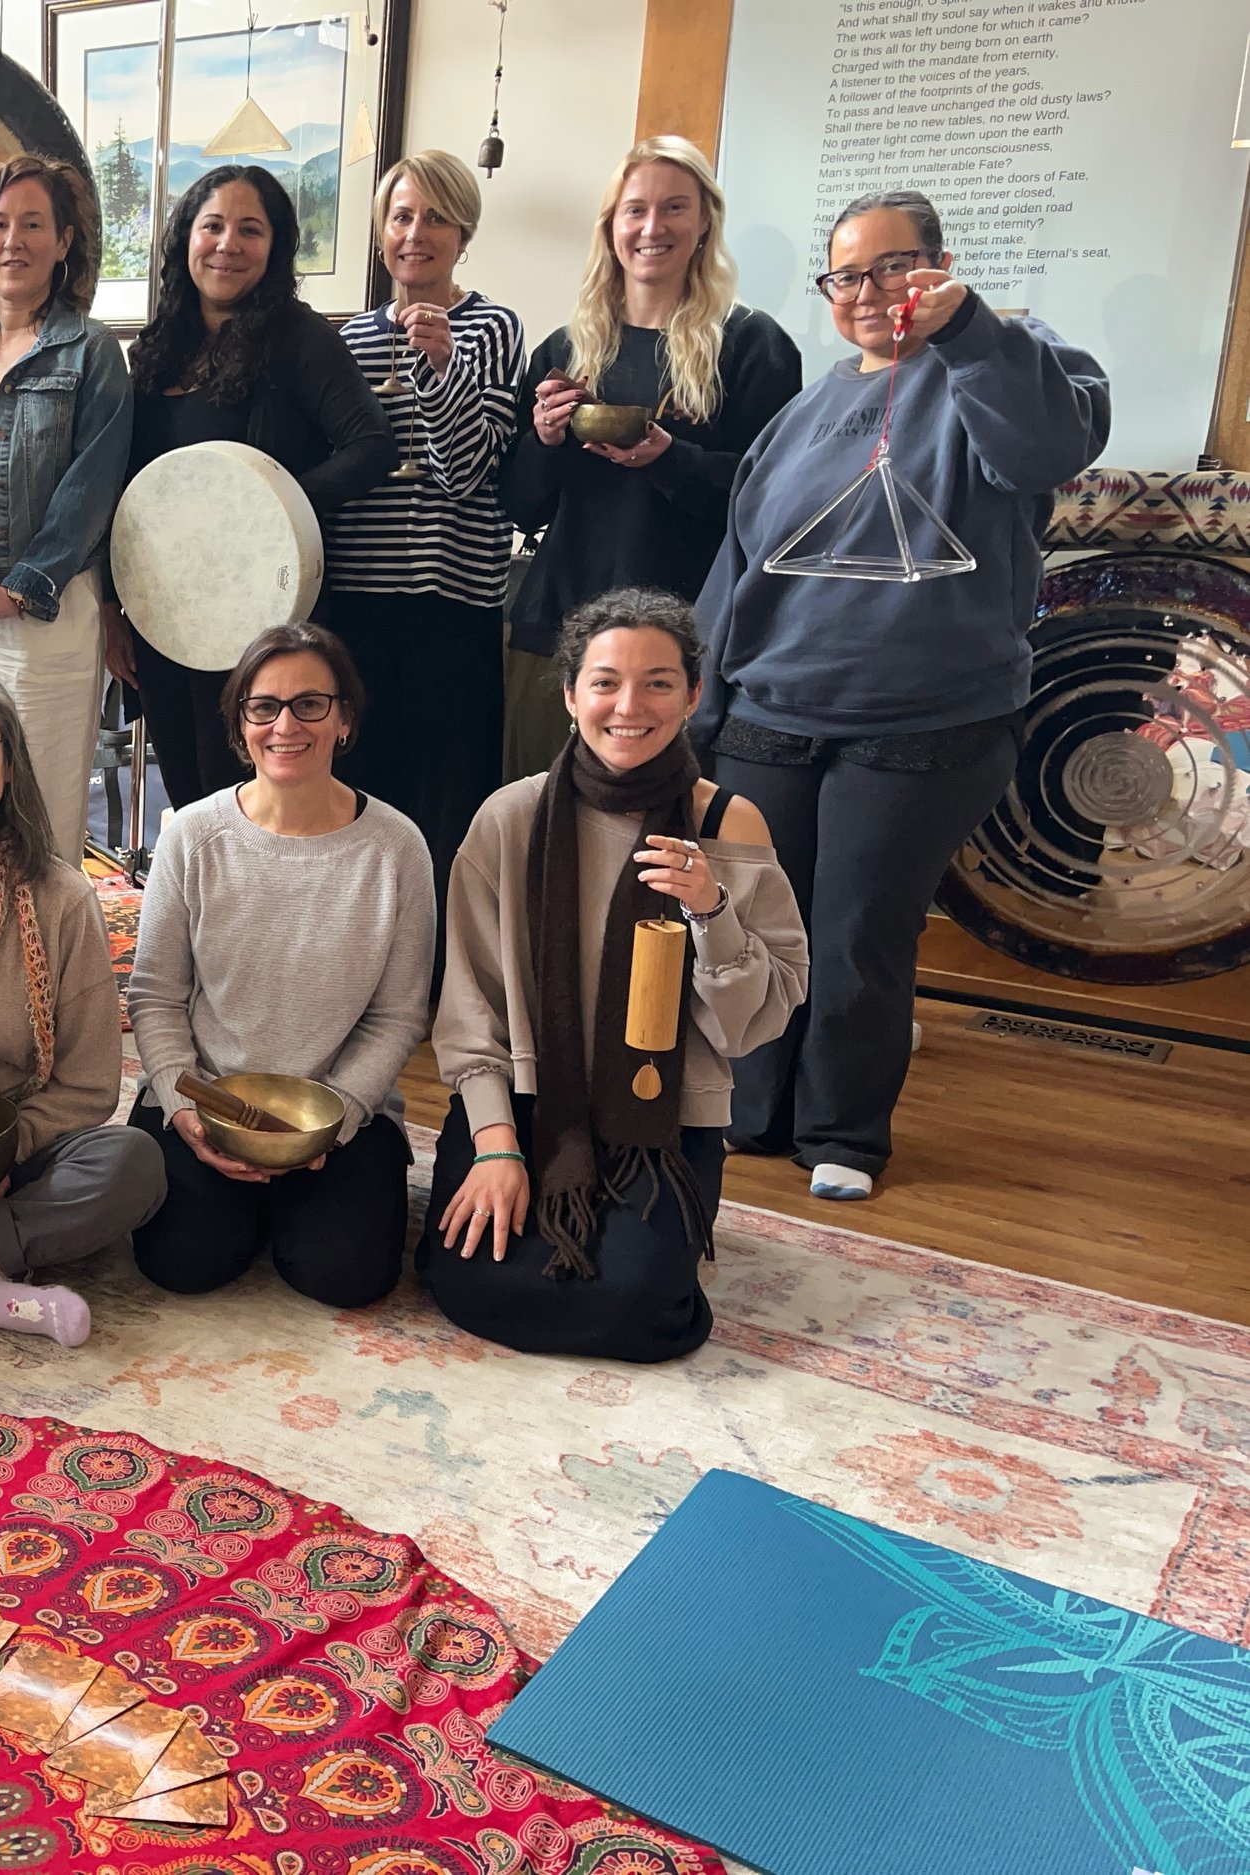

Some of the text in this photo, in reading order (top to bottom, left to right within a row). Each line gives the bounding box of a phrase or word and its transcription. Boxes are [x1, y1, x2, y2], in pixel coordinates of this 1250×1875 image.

[836, 17, 860, 28] And
[862, 15, 889, 26] what
[892, 11, 918, 24] shall
[921, 11, 939, 23] thy
[941, 7, 966, 20] soul
[968, 8, 989, 19] say
[992, 4, 1024, 16] when
[1027, 3, 1034, 12] it
[1037, 0, 1076, 12] wakes
[856, 1, 875, 12] this
[836, 13, 1090, 43] The work was left undone for which it came?
[833, 32, 1053, 59] Or is this all for thy being born on earth
[831, 48, 1058, 74] Charged with the mandate from eternity,
[829, 67, 1029, 89] A listener to the voices of the years,
[827, 79, 1043, 104] A follower of the footprints of the gods,
[826, 89, 1112, 120] To pass and leave unchanged the old dusty laws?
[824, 108, 1070, 134] Shall there be no new tables, no new Word,
[822, 124, 1063, 150] No greater light come down upon the earth
[820, 142, 1053, 164] Delivering her from her unconsciousness,
[818, 157, 1013, 178] Man's spirit from unalterable Fate?
[858, 181, 882, 190] thou
[907, 178, 936, 187] down
[940, 177, 951, 186] to
[953, 176, 982, 188] open
[986, 174, 1004, 184] the
[1007, 172, 1040, 183] doors
[1043, 170, 1056, 182] of
[1058, 170, 1088, 181] Fate,
[815, 198, 835, 208] The
[970, 189, 1011, 201] forever
[1013, 186, 1055, 198] closed,
[813, 213, 835, 222] And
[948, 205, 974, 216] wide
[977, 204, 999, 215] and
[1002, 202, 1042, 217] golden
[1045, 200, 1073, 212] road
[813, 217, 1044, 237] Tha things to eternity?
[810, 243, 820, 252] Is
[959, 236, 988, 245] must
[991, 234, 1026, 245] make,
[809, 257, 825, 269] My
[964, 249, 1001, 261] before
[1004, 249, 1023, 260] the
[1026, 247, 1078, 259] Eternal's
[1082, 247, 1111, 258] seat,
[957, 265, 985, 278] body
[988, 265, 1009, 275] has
[1013, 263, 1047, 275] failed,
